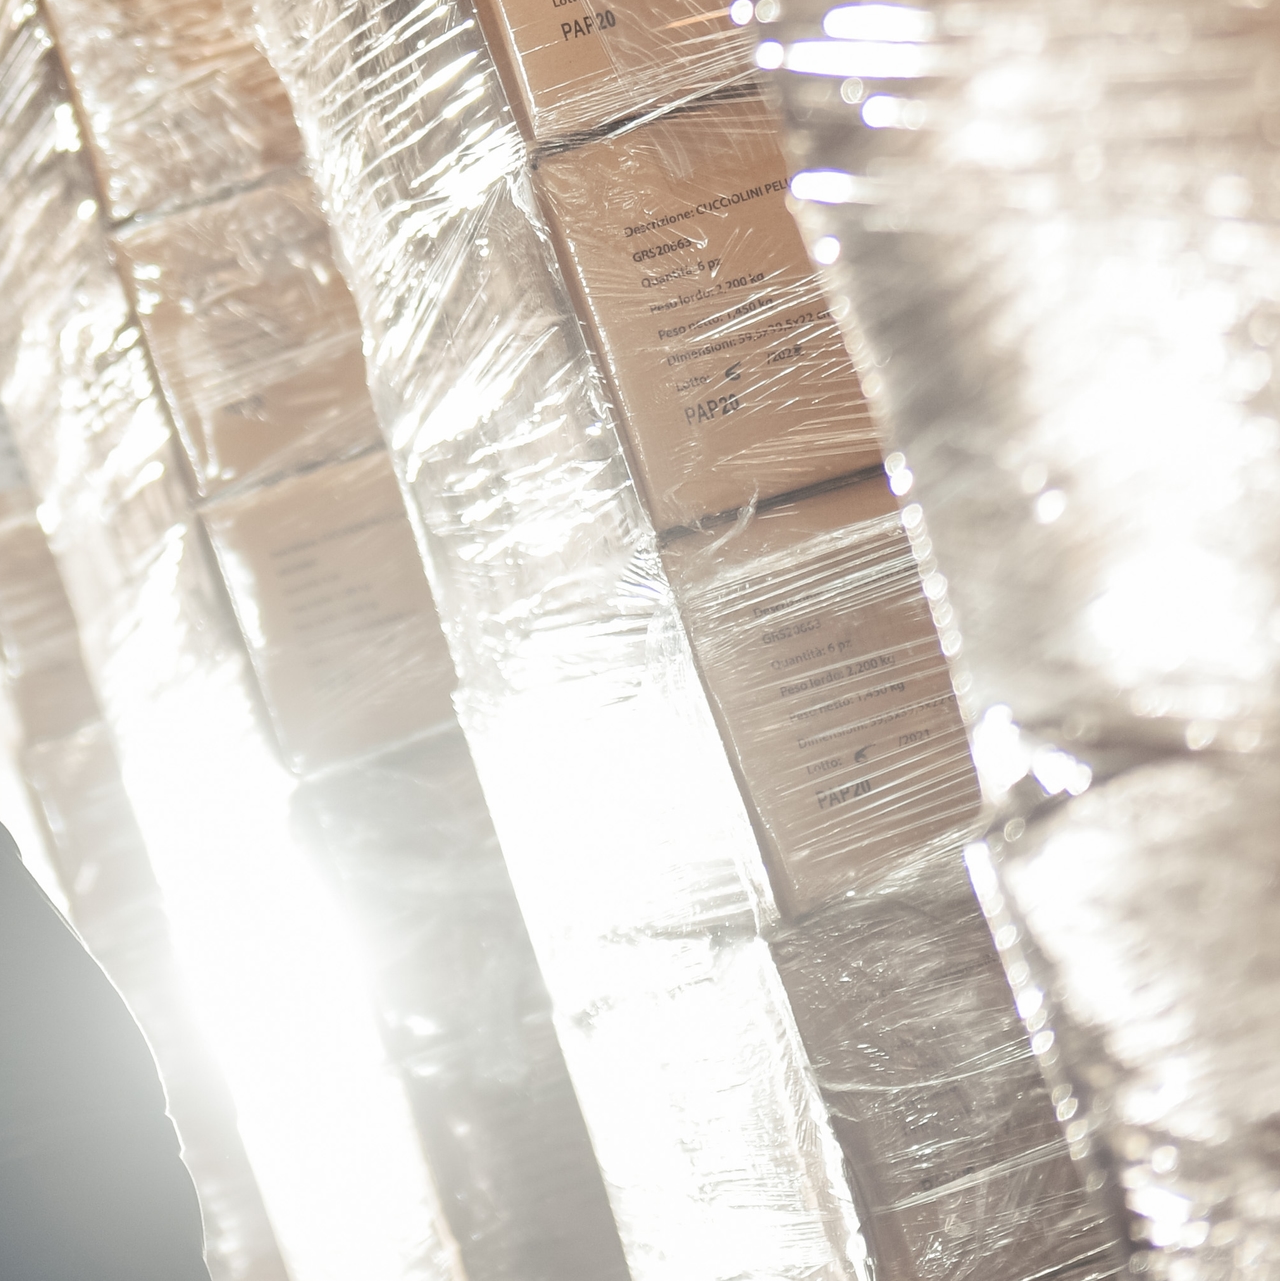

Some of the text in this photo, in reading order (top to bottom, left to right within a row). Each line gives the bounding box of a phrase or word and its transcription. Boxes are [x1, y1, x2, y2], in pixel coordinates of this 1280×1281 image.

[624, 209, 695, 238] Descrizione:
[696, 188, 764, 216] CUCCIOLINI
[697, 260, 706, 272] 6
[658, 324, 686, 340] Peso
[771, 646, 827, 672] Quantità:
[827, 642, 836, 653] 6
[780, 683, 809, 698] Peso
